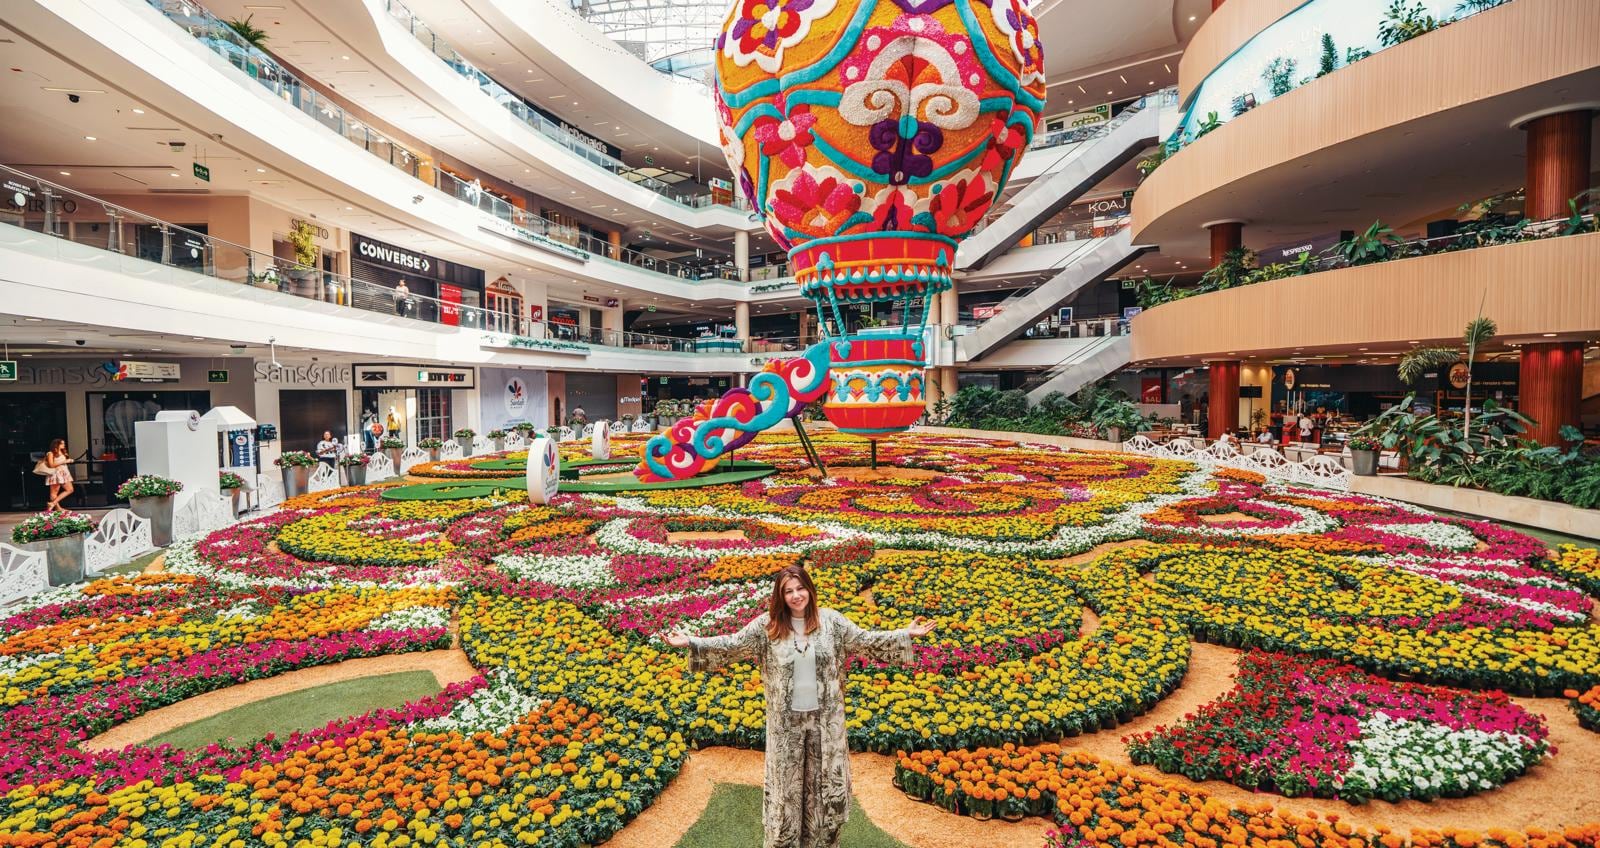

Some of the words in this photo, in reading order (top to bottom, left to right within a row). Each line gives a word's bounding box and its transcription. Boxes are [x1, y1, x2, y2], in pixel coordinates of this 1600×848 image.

[1088, 198, 1127, 213] KOAJ
[360, 241, 421, 270] CONVERSE
[1282, 244, 1313, 257] NESPRESSO
[254, 360, 350, 387] Samsonite
